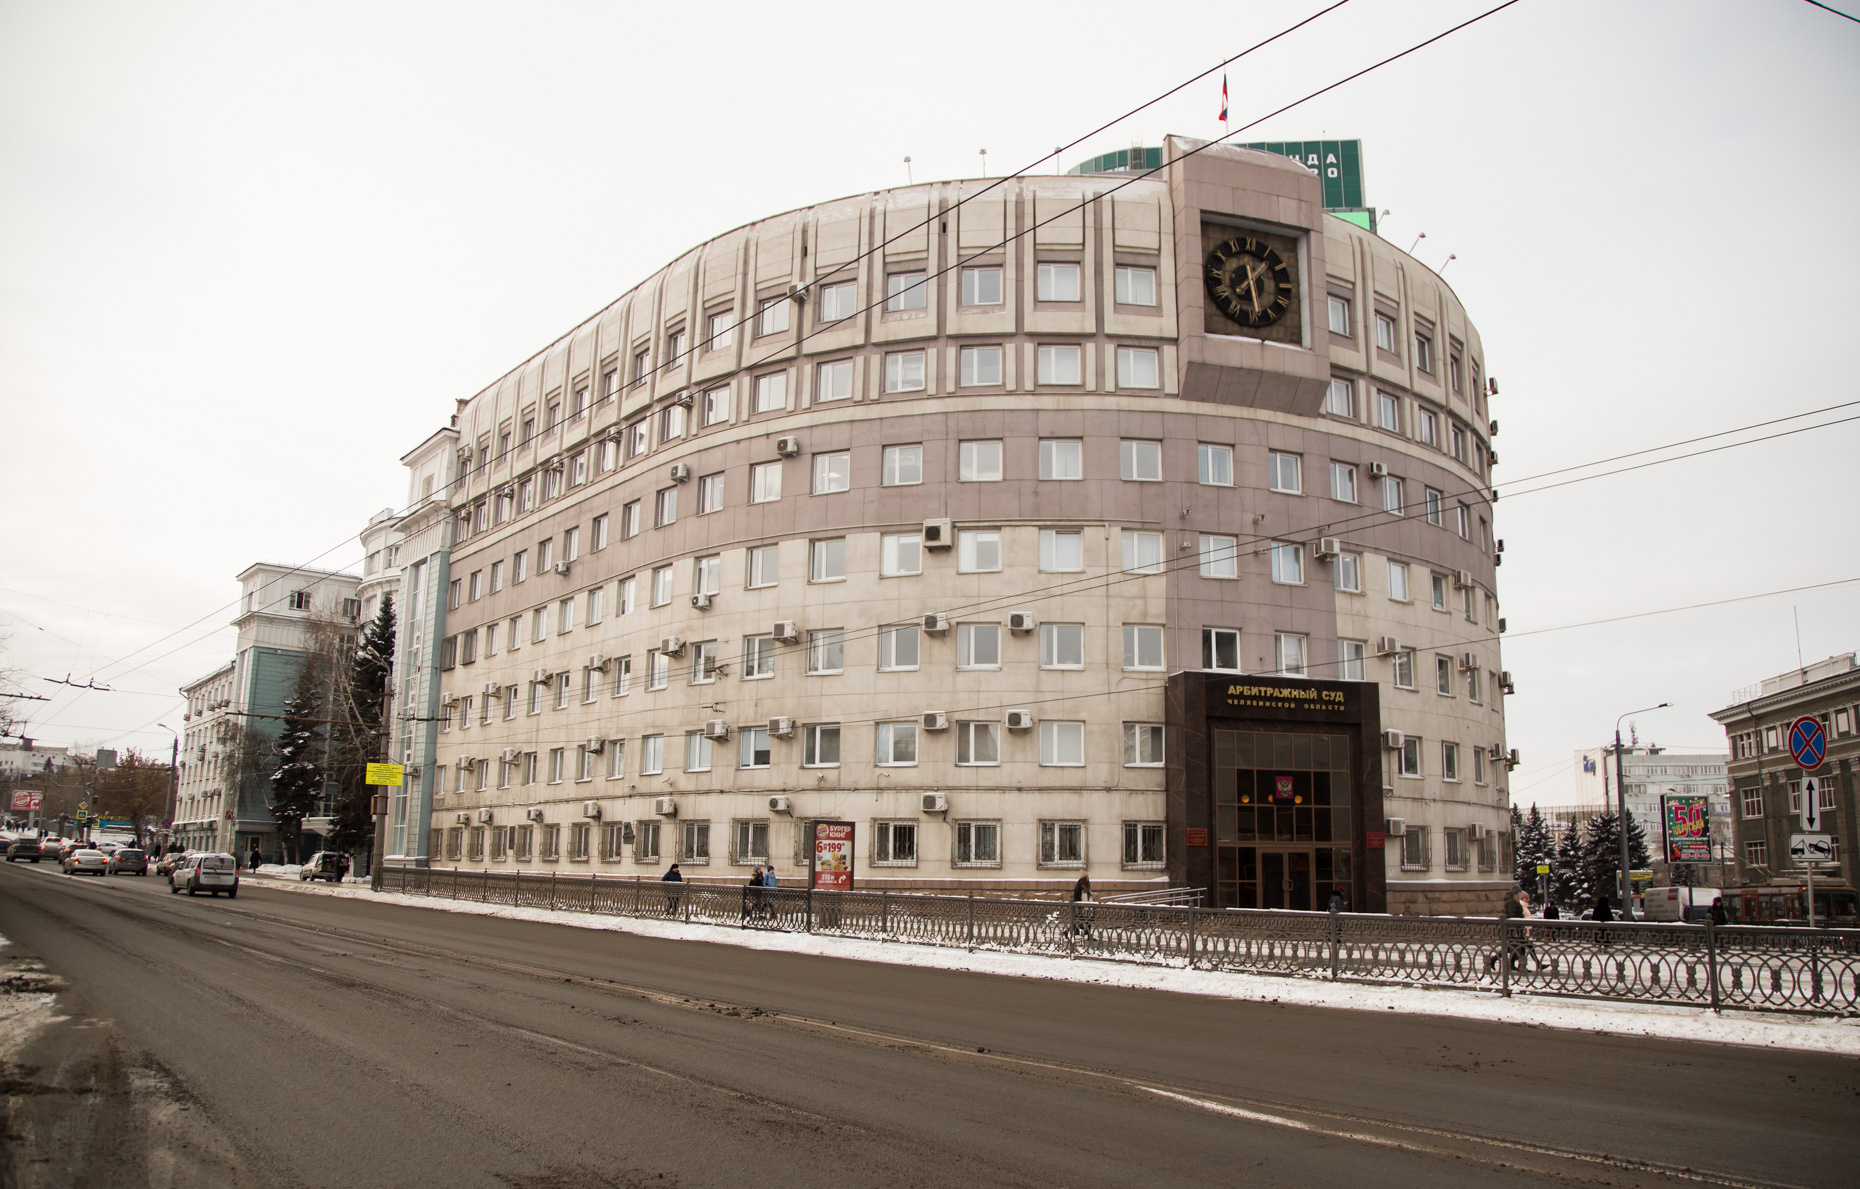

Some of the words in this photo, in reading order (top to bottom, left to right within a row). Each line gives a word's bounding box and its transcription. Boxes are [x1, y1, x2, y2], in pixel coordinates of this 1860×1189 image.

[1228, 685, 1318, 700] АРБИТРАЖНЫЙ
[1322, 691, 1345, 702] СУД
[1227, 699, 1296, 709] ЧЕЛЯБИНСКОЙ
[1303, 703, 1345, 711] ОБЛАСТИ
[1674, 805, 1702, 837] 50
[816, 841, 823, 853] 6
[828, 842, 842, 852] 199
